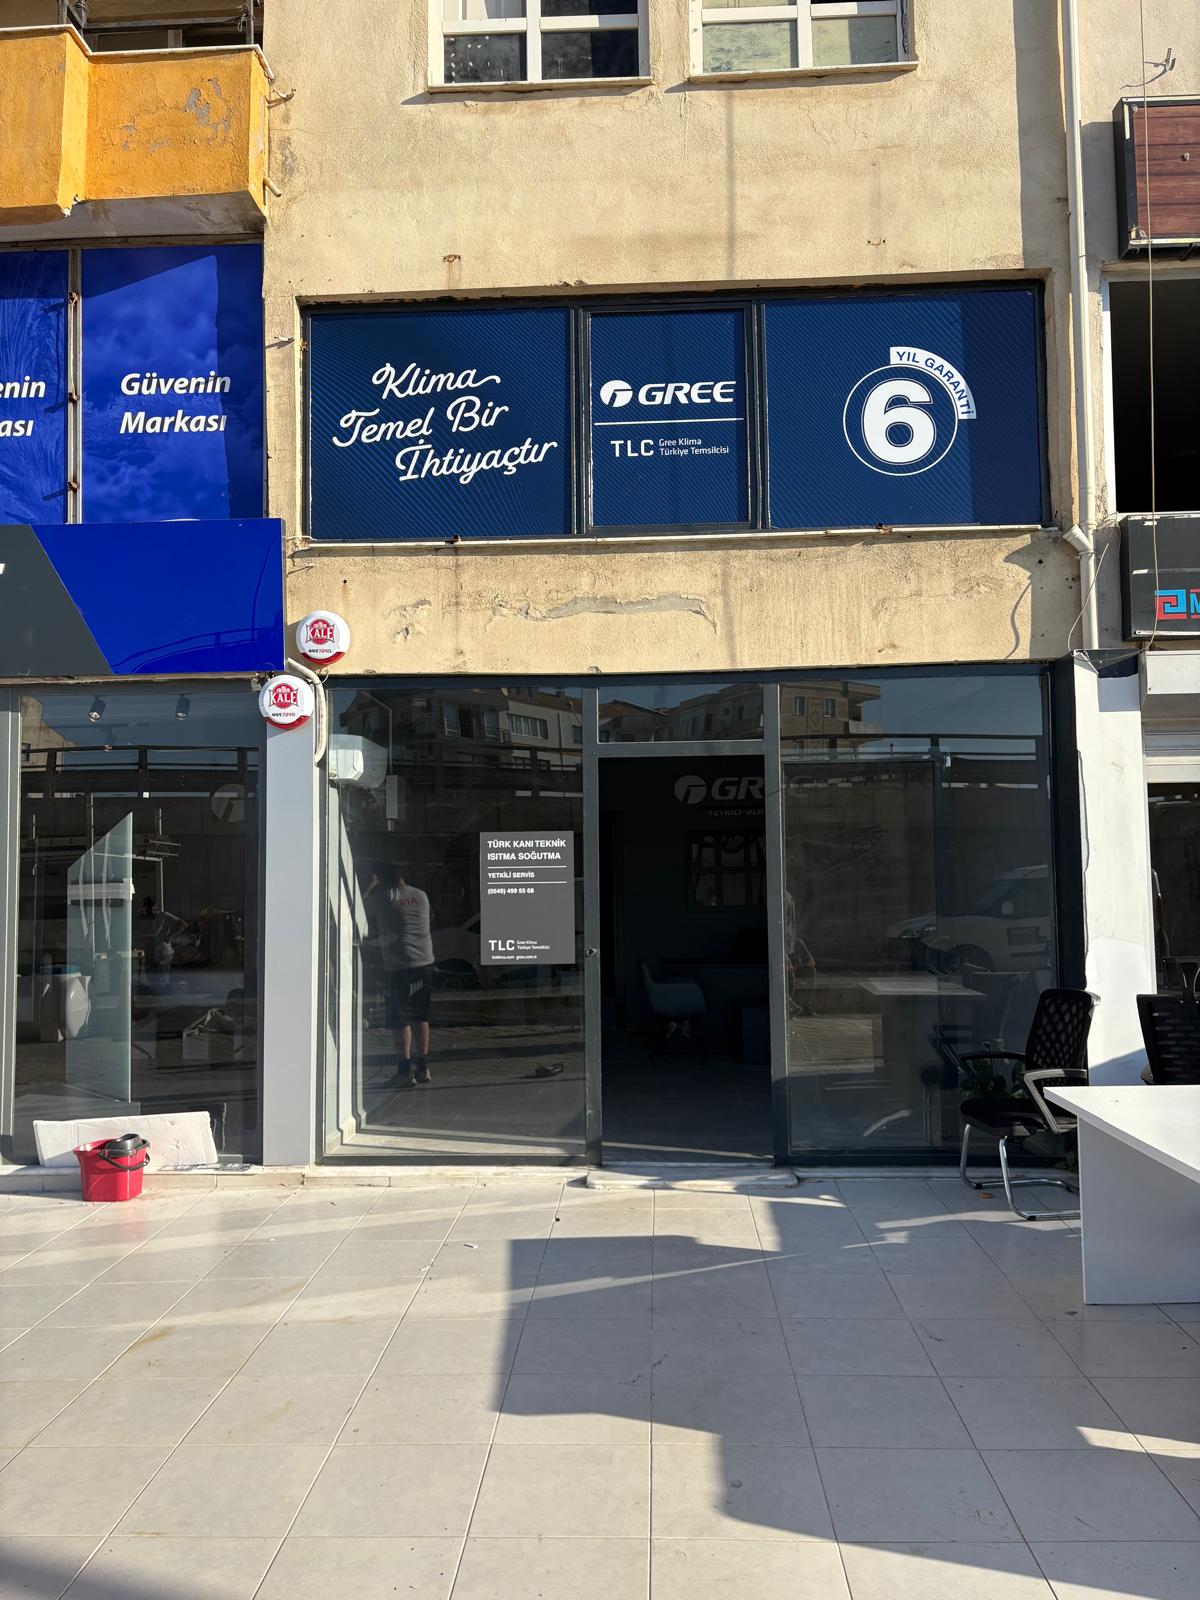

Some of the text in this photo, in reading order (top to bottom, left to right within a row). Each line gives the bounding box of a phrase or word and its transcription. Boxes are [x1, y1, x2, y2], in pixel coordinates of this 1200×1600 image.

[0, 375, 46, 399] nin
[120, 370, 232, 396] Güvenin
[371, 362, 502, 400] Klima
[638, 380, 737, 406] GREE
[896, 350, 975, 416] YIL GARANTİ
[119, 409, 228, 434] Markası
[332, 395, 510, 448] Temel Bir
[860, 377, 937, 466] 6
[610, 439, 654, 458] TLC
[658, 437, 702, 446] Gree Klima
[659, 446, 730, 457] Türkiye Temsilcisi
[395, 437, 558, 485] İhtiyaçtır
[307, 626, 335, 641] KALE
[270, 691, 298, 705] KALE
[487, 837, 567, 848] TÜRK KANI TEKNİK
[487, 850, 561, 861] ISITMA SOĞUTMA
[488, 939, 515, 951] TLC
